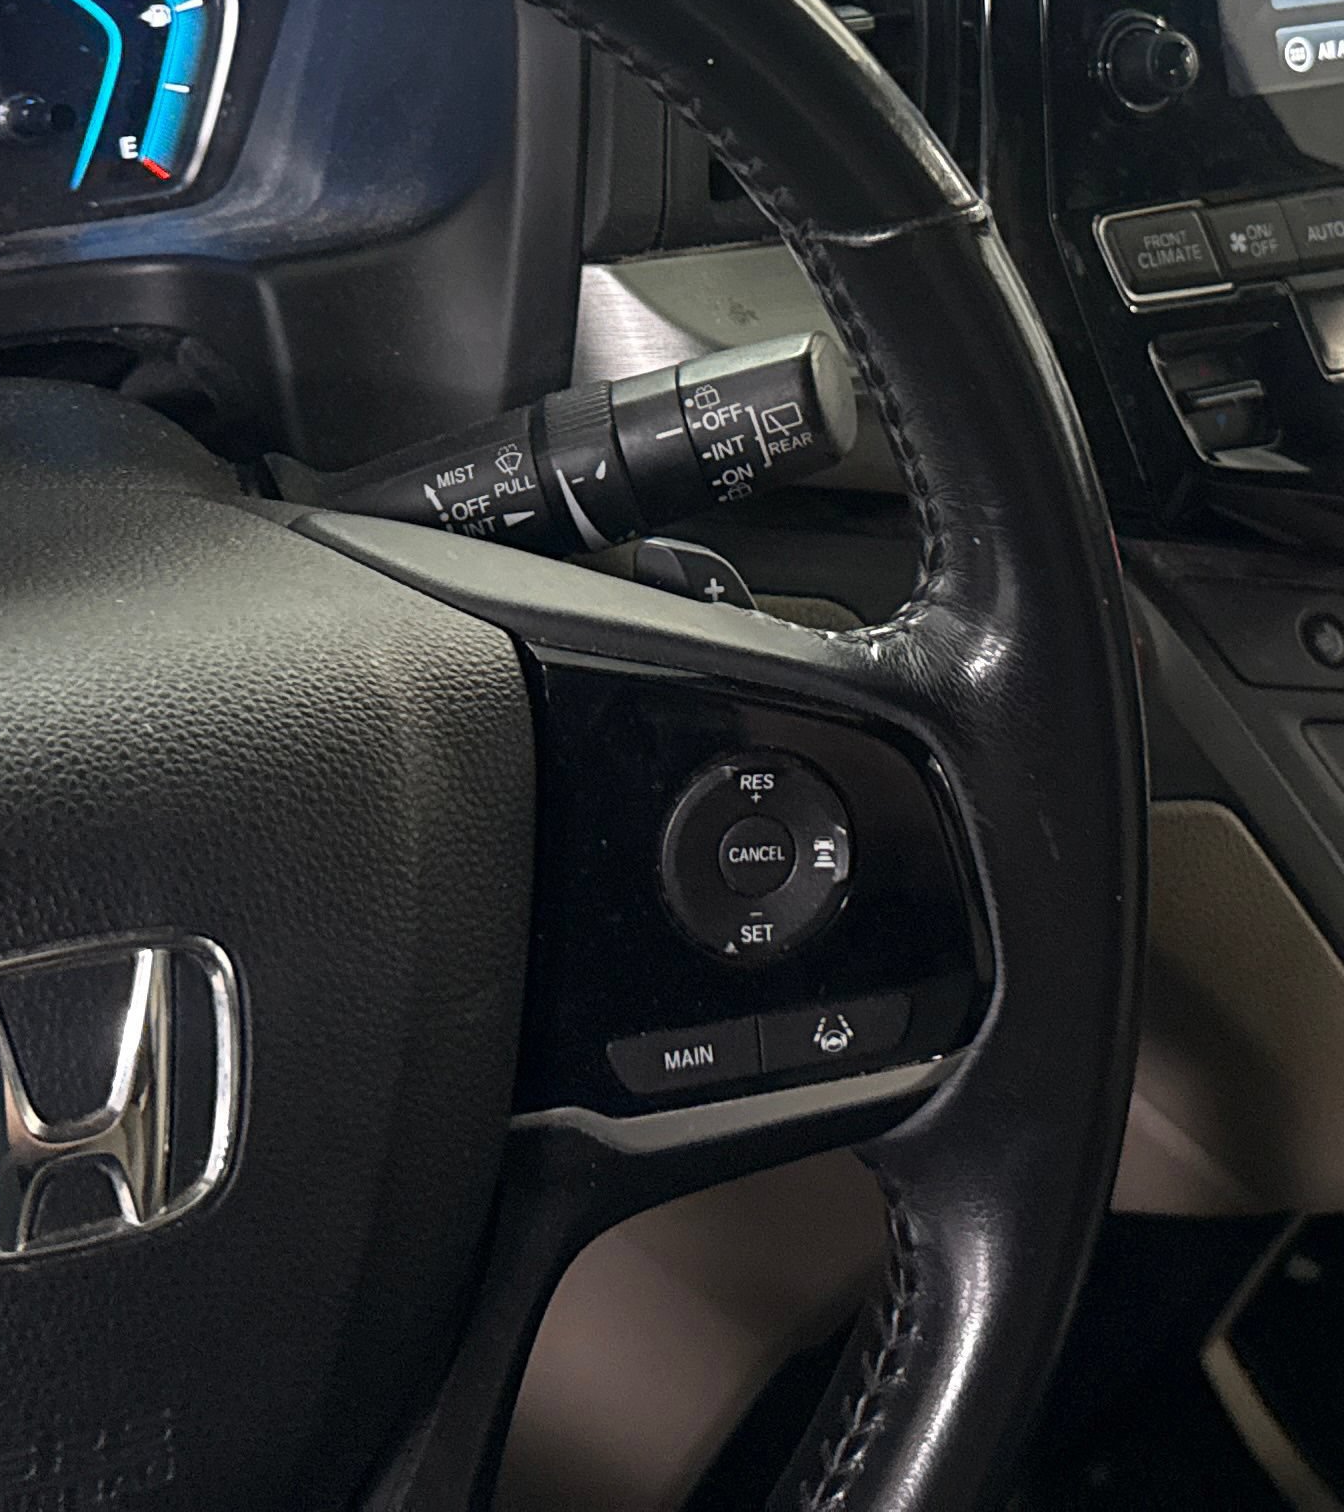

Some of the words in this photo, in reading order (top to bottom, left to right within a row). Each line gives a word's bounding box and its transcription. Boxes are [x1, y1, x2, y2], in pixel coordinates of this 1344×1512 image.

[1317, 39, 1337, 61] All
[119, 136, 138, 160] E
[1142, 230, 1187, 250] FRONT
[1251, 239, 1280, 258] OFF
[1137, 244, 1203, 270] CLIMATE
[701, 404, 744, 431] OFF
[712, 434, 745, 462] INT
[768, 432, 814, 458] REAR
[436, 463, 475, 489] MIST
[721, 463, 754, 486] ON
[494, 476, 536, 499] PULL
[451, 495, 491, 522] OFF
[464, 516, 497, 536] INT
[740, 774, 775, 790] RES
[728, 845, 785, 863] CANCEL
[741, 923, 774, 944] SET
[664, 1043, 715, 1072] MAIN
